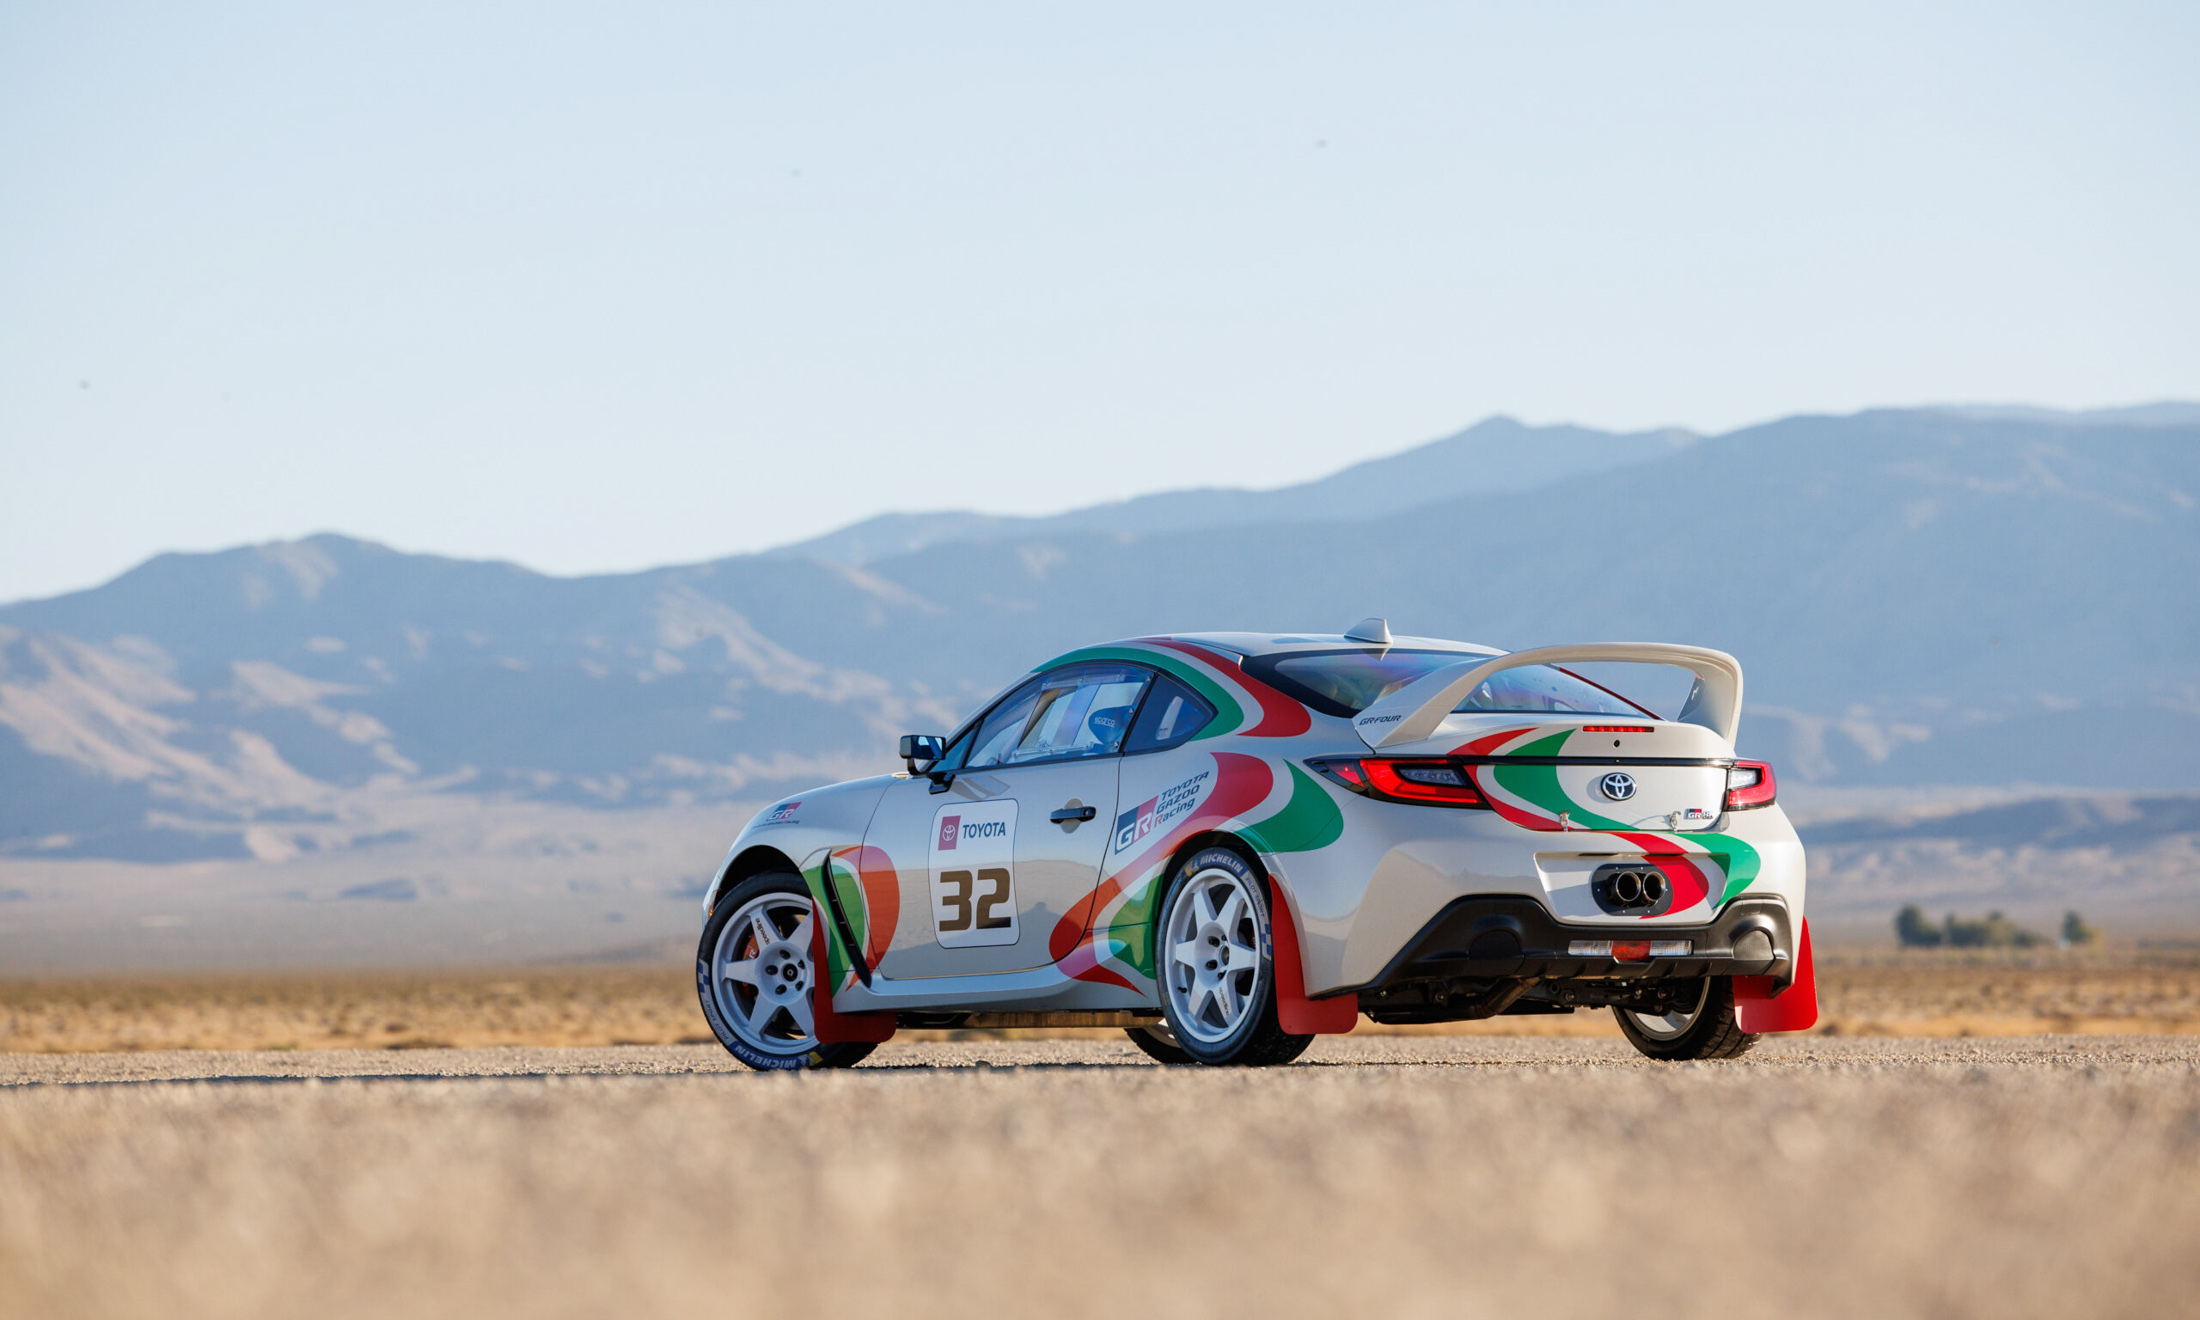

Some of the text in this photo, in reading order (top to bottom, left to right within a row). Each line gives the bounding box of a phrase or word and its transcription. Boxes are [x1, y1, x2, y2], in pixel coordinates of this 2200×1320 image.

[1094, 716, 1115, 728] sparco
[1156, 784, 1200, 815] GAZOO
[1161, 771, 1209, 801] TOYOTA
[1154, 798, 1195, 828] Racing
[962, 821, 1006, 839] TOYOTA
[1116, 808, 1154, 853] GR
[1200, 853, 1243, 873] MICHELIN
[939, 867, 1011, 932] 32
[1245, 877, 1265, 918] PILOT SPORT
[705, 1000, 730, 1040] PILOT SPORT
[734, 1045, 797, 1069] MICHELIN
